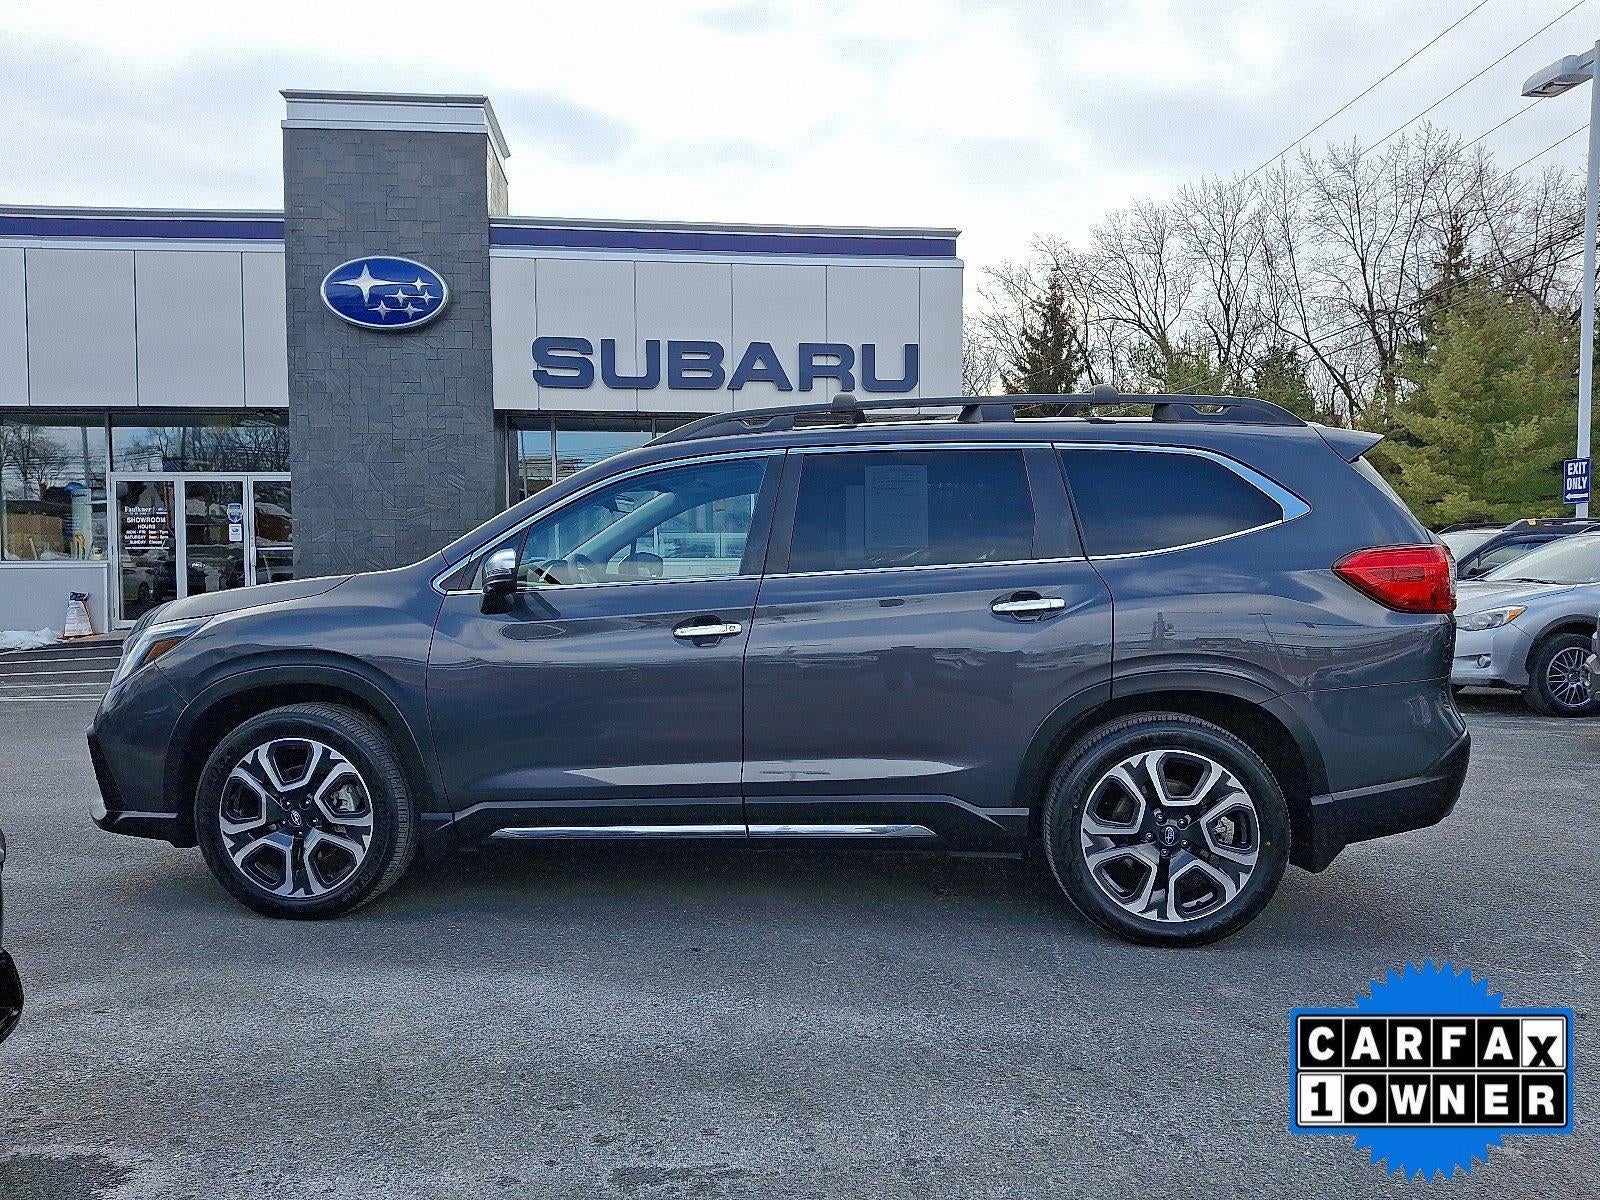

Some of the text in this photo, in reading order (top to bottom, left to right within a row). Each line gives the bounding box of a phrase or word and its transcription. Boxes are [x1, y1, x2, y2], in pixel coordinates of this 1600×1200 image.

[531, 336, 919, 393] SUBARU
[1568, 462, 1587, 475] EXIT
[1567, 477, 1587, 490] ONLY
